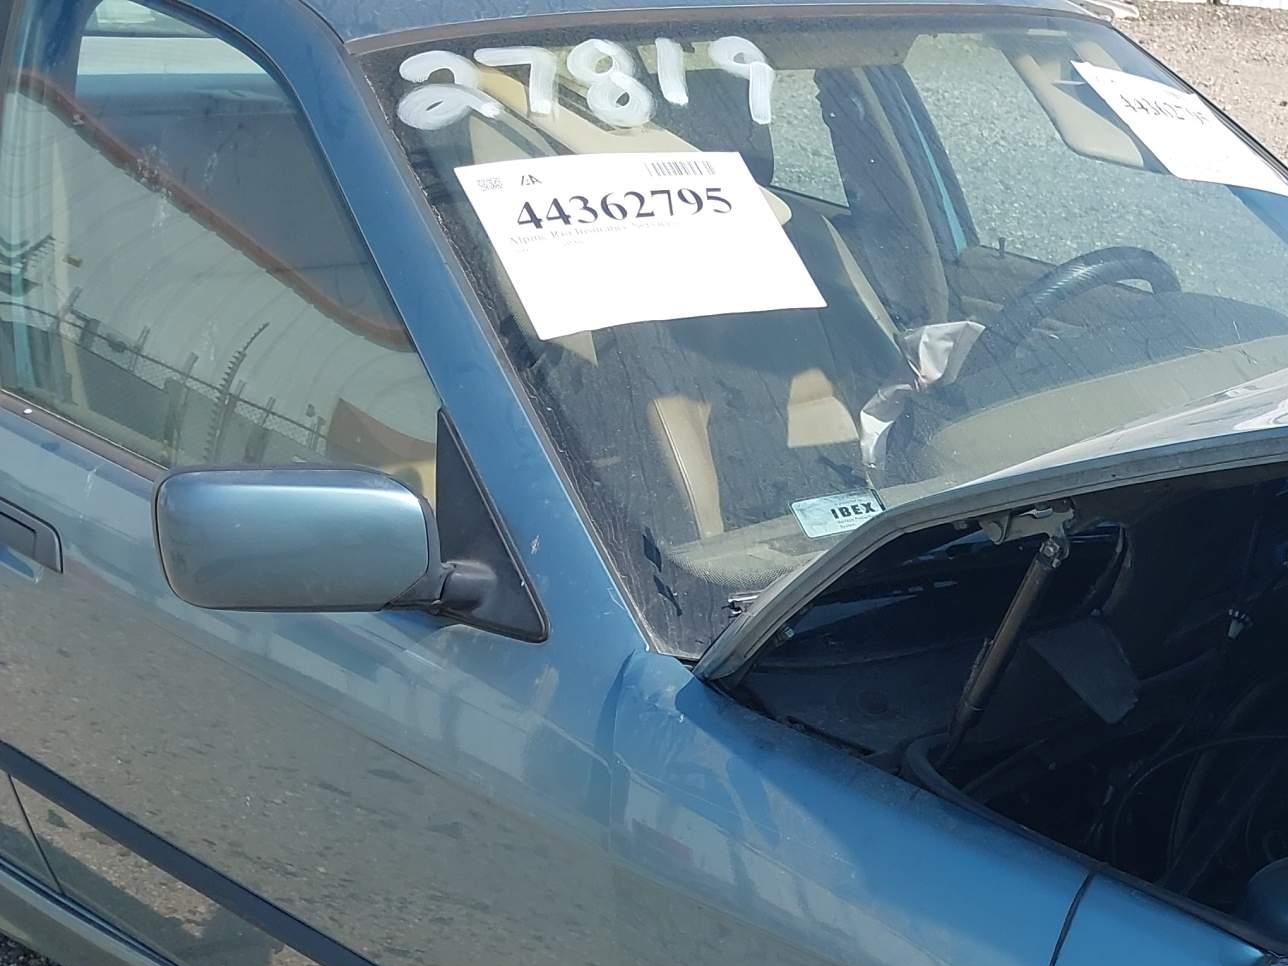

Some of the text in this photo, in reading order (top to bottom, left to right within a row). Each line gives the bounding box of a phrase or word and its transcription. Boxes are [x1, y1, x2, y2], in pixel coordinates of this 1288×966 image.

[397, 36, 774, 130] 27819
[516, 187, 733, 230] 44362795
[830, 502, 876, 519] IBEX
